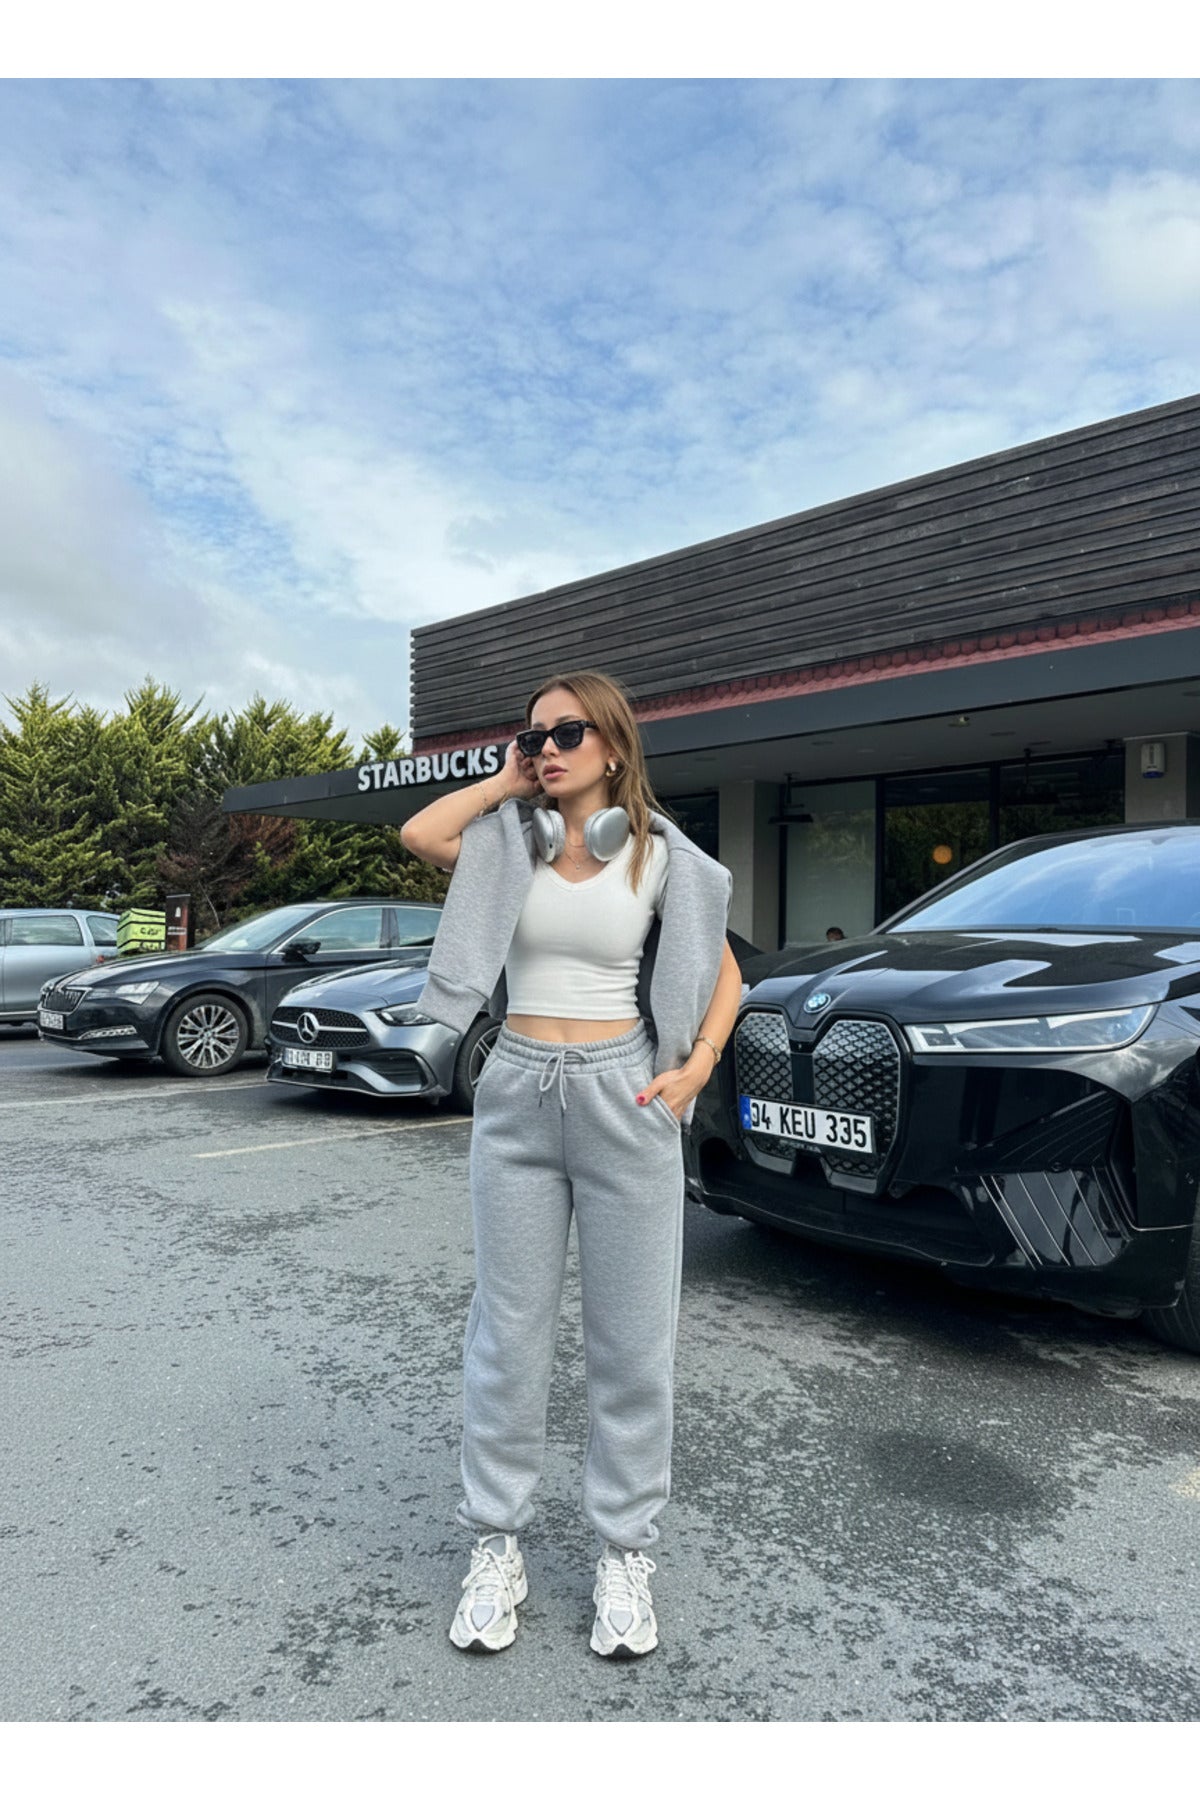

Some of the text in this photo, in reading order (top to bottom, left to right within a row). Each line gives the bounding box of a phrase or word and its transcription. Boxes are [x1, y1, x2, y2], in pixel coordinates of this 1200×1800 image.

[358, 746, 498, 791] STARBUCKS
[780, 1106, 816, 1139] KEU
[826, 1114, 867, 1148] 335
